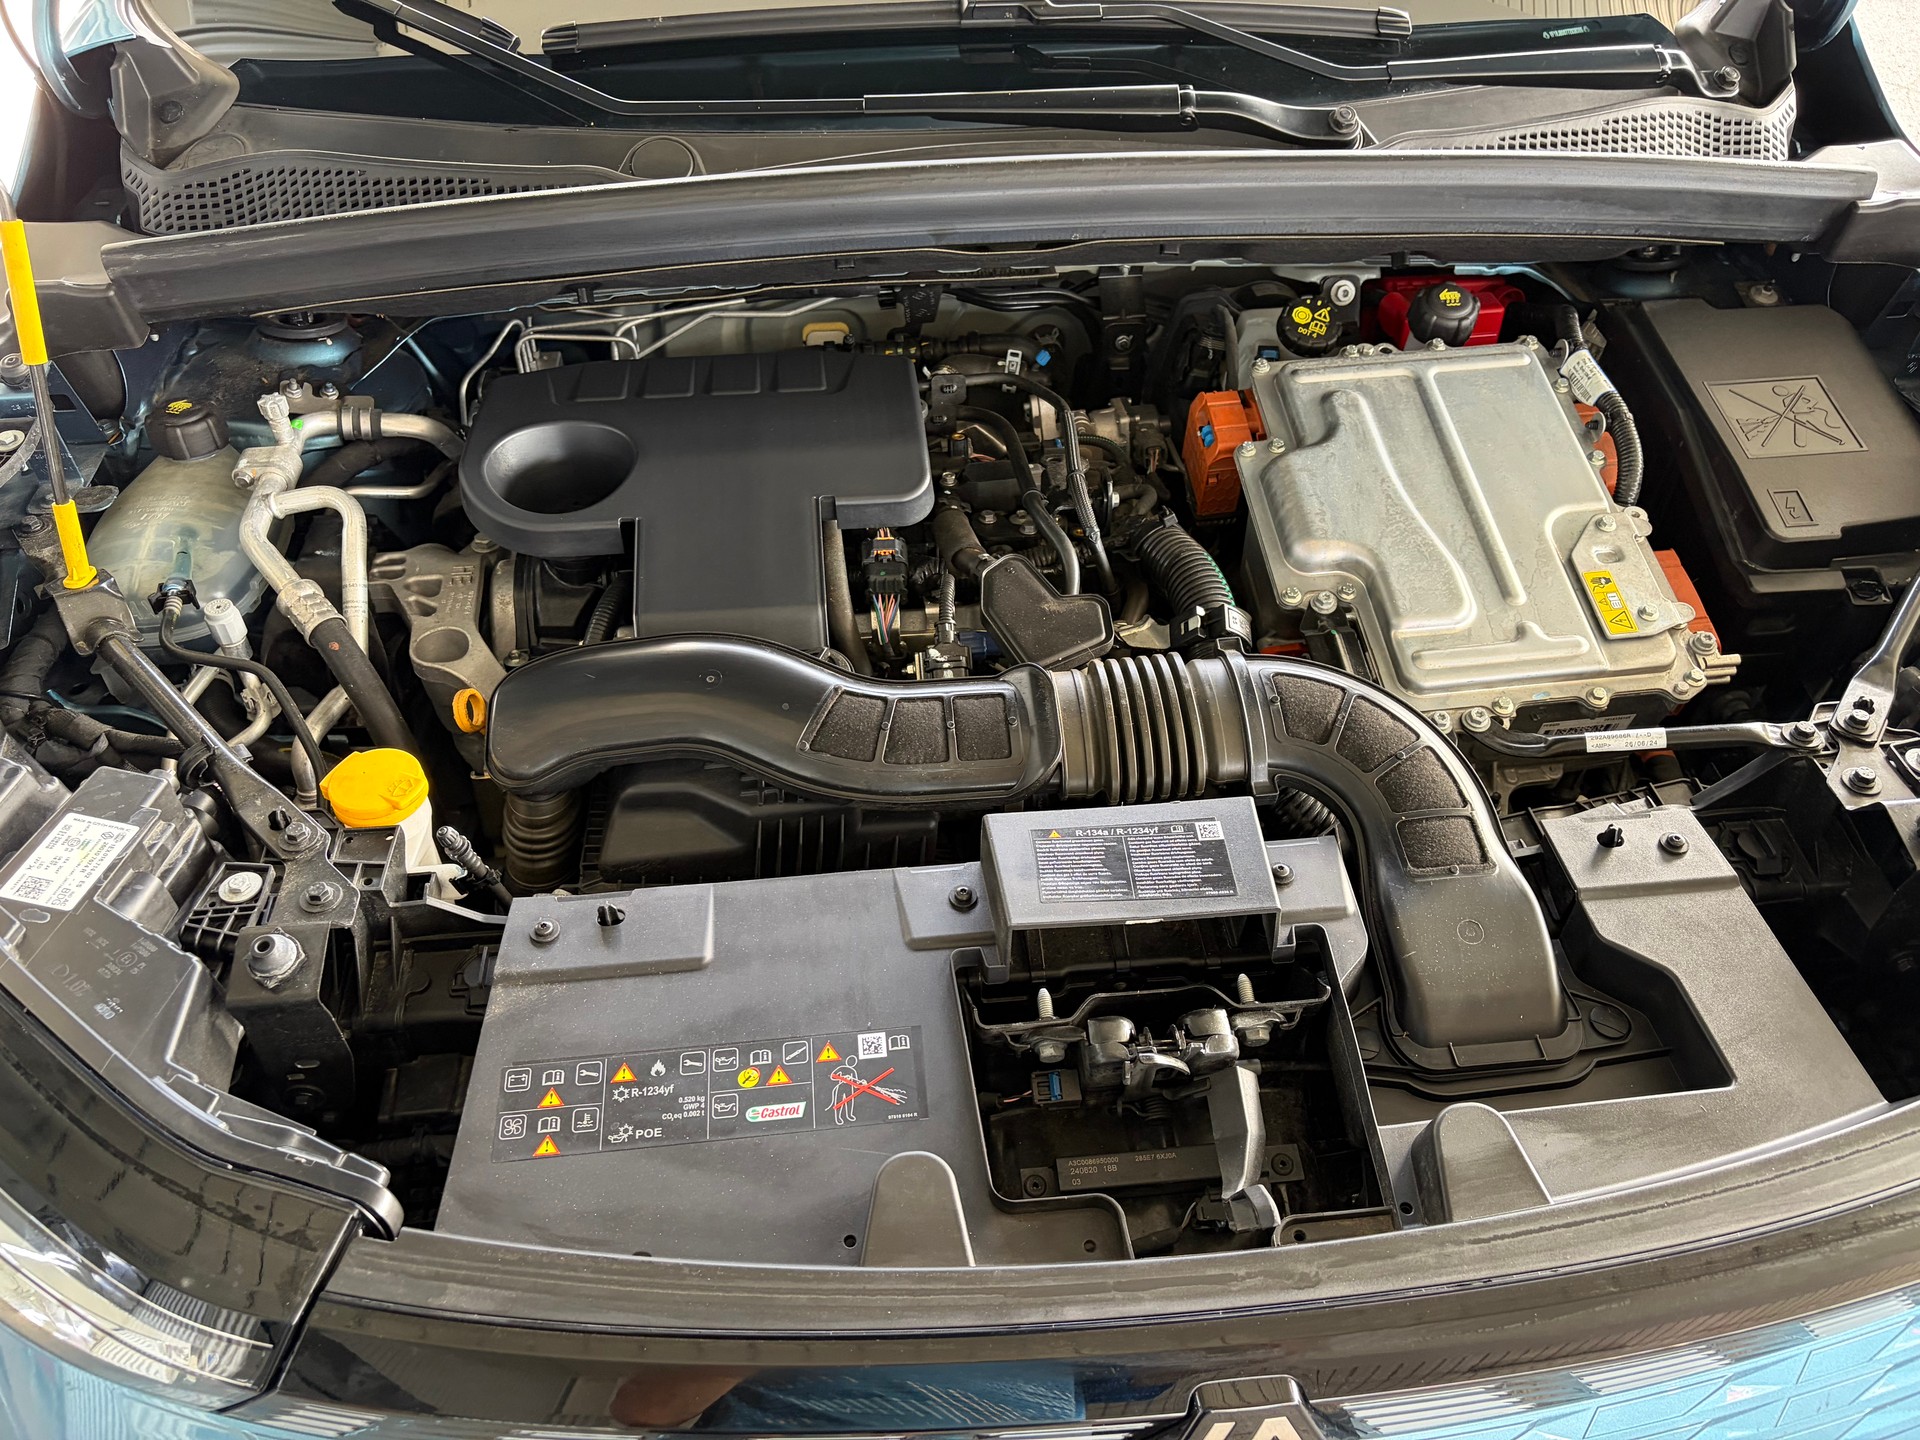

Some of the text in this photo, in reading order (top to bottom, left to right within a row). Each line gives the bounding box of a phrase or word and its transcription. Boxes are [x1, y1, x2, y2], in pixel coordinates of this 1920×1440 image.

[1298, 326, 1311, 336] DOT
[1076, 828, 1109, 836] R-134a
[1117, 827, 1158, 835] R-1234yf
[631, 1084, 674, 1097] R-1234yf
[761, 1104, 800, 1118] Castrol
[635, 1128, 662, 1139] POE
[1072, 1178, 1081, 1186] 03
